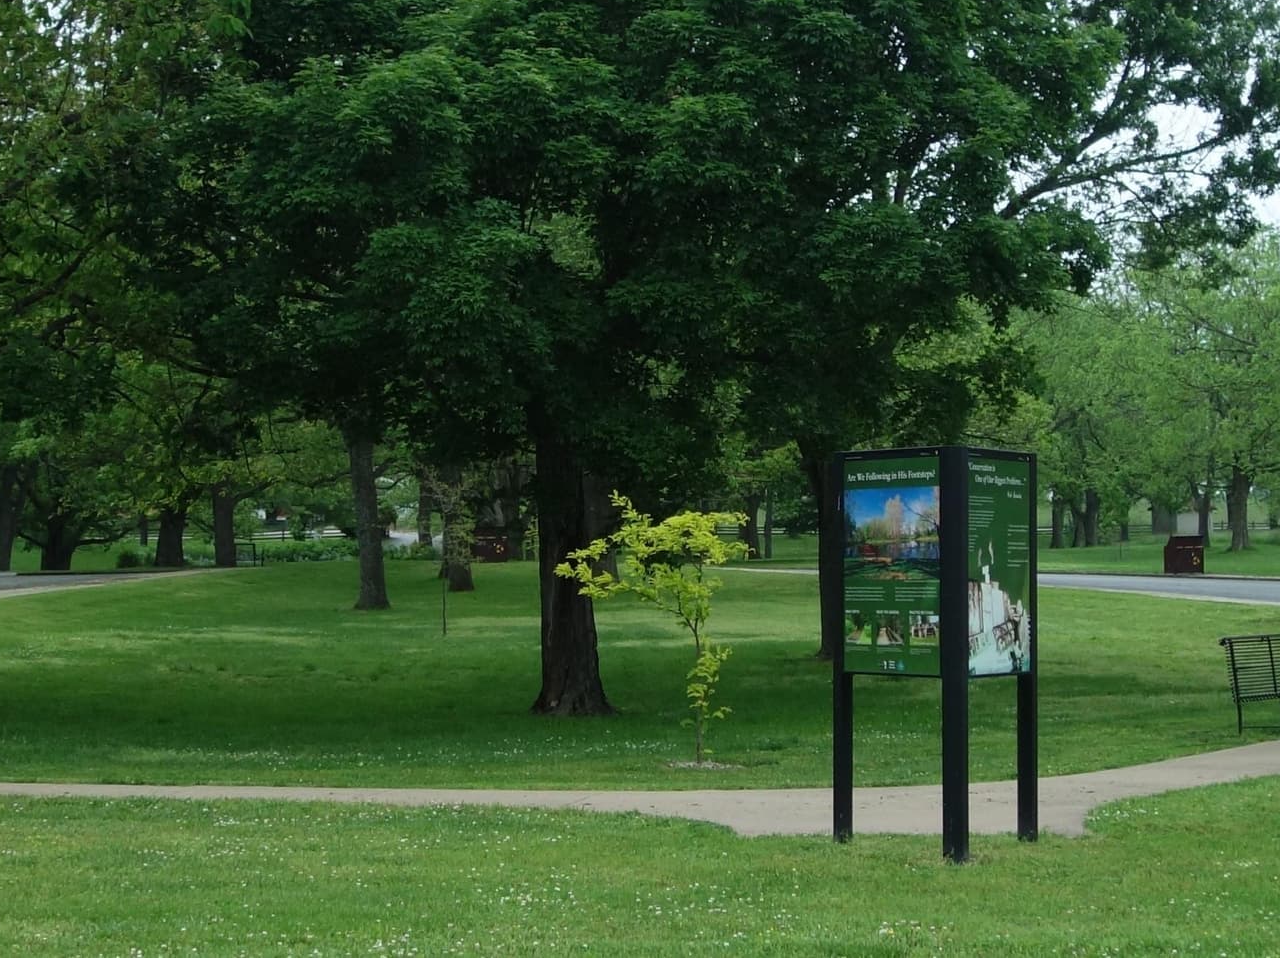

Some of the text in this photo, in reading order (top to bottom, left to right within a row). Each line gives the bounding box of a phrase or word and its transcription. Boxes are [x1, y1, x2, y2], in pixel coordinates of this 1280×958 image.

[847, 474, 856, 482] Are
[857, 472, 865, 481] We
[865, 471, 891, 482] Following
[891, 471, 897, 480] in
[898, 470, 907, 480] His
